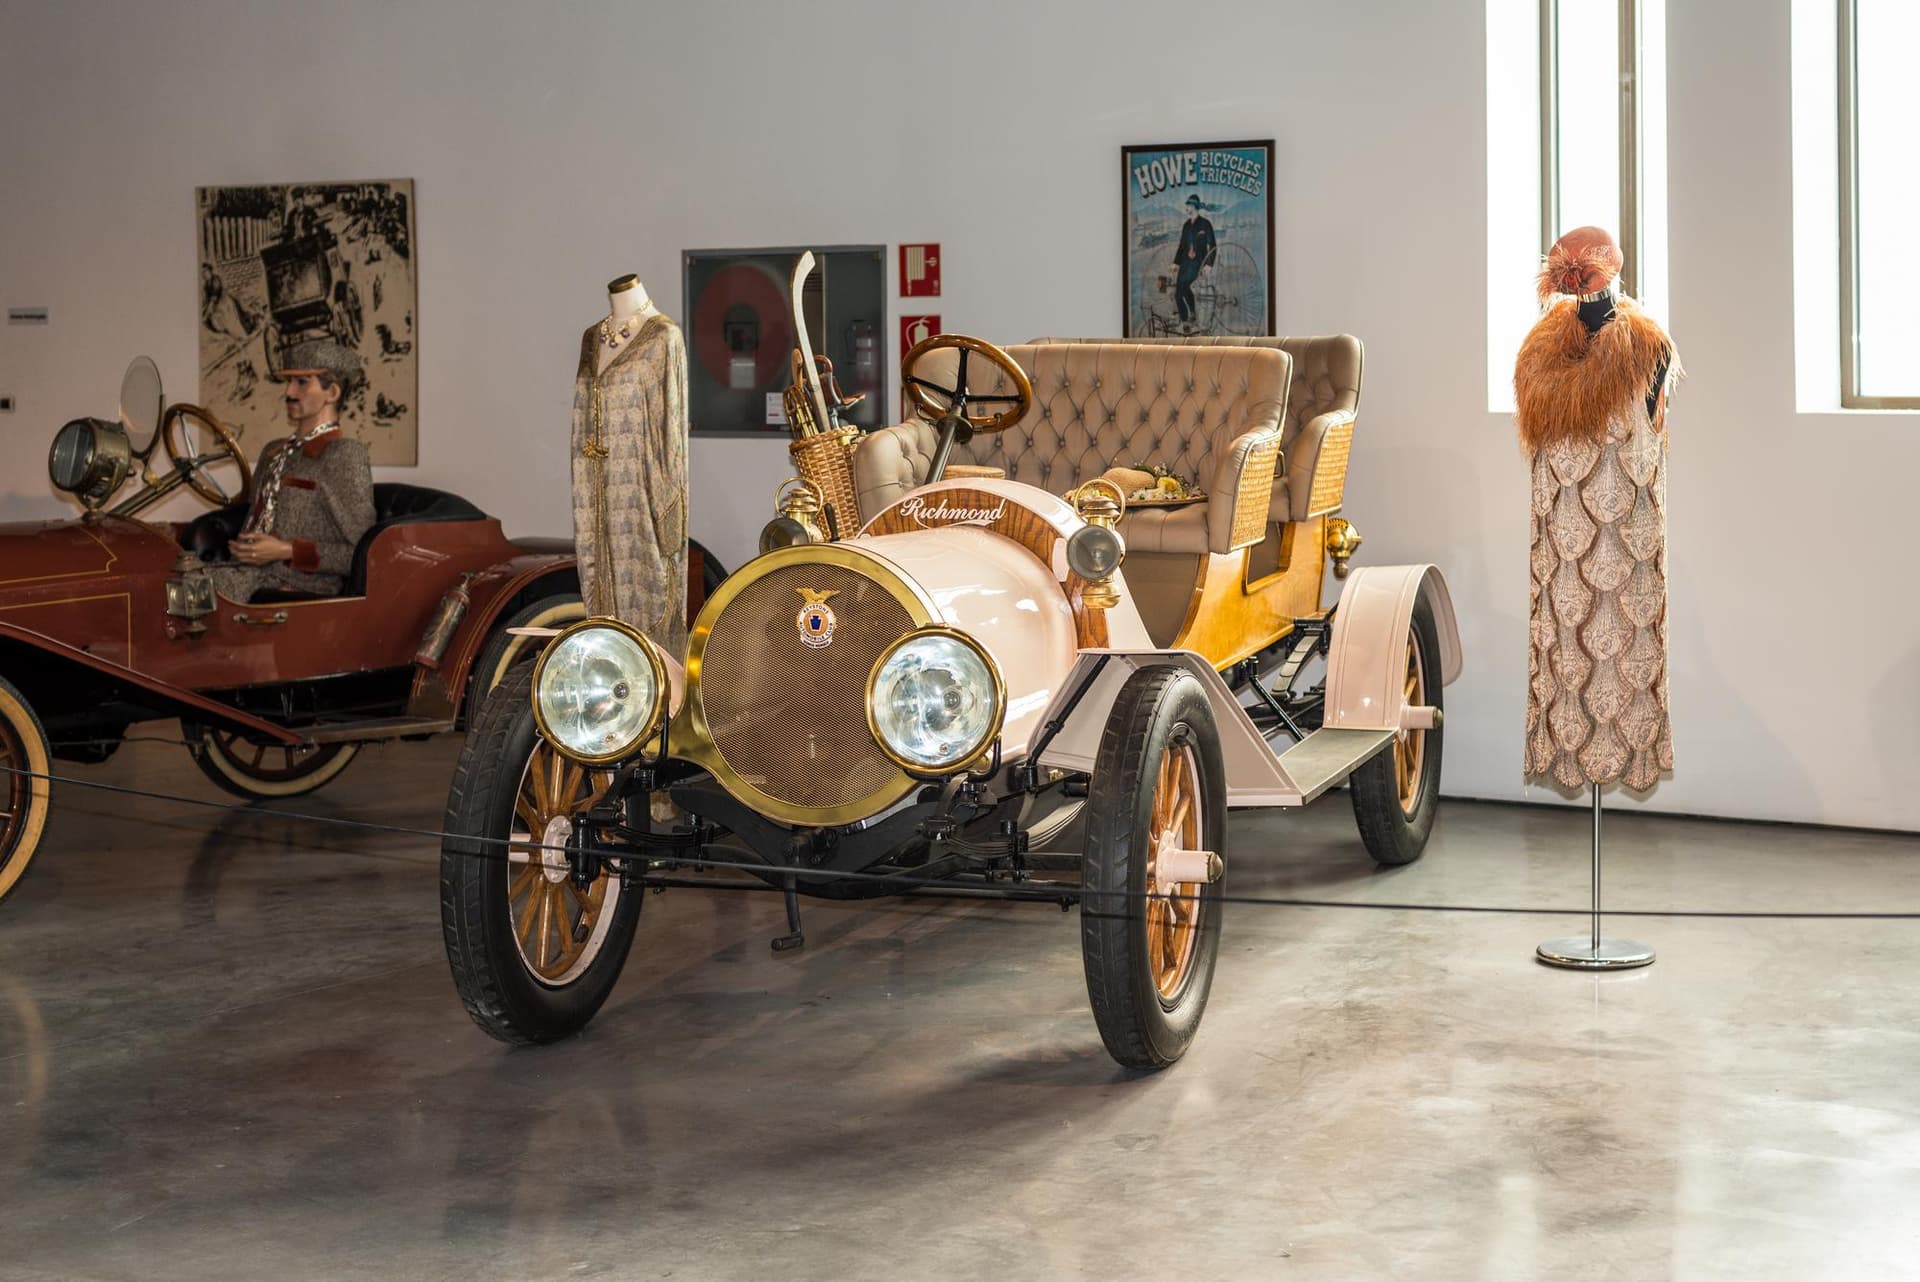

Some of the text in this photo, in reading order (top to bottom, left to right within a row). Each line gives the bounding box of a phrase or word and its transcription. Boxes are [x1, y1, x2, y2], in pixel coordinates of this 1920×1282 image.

[1135, 151, 1261, 197] HOWE BICYCLES
[1200, 166, 1262, 195] TRICYCLES
[899, 496, 1007, 529] Richmond
[803, 604, 829, 614] KEYSTONE
